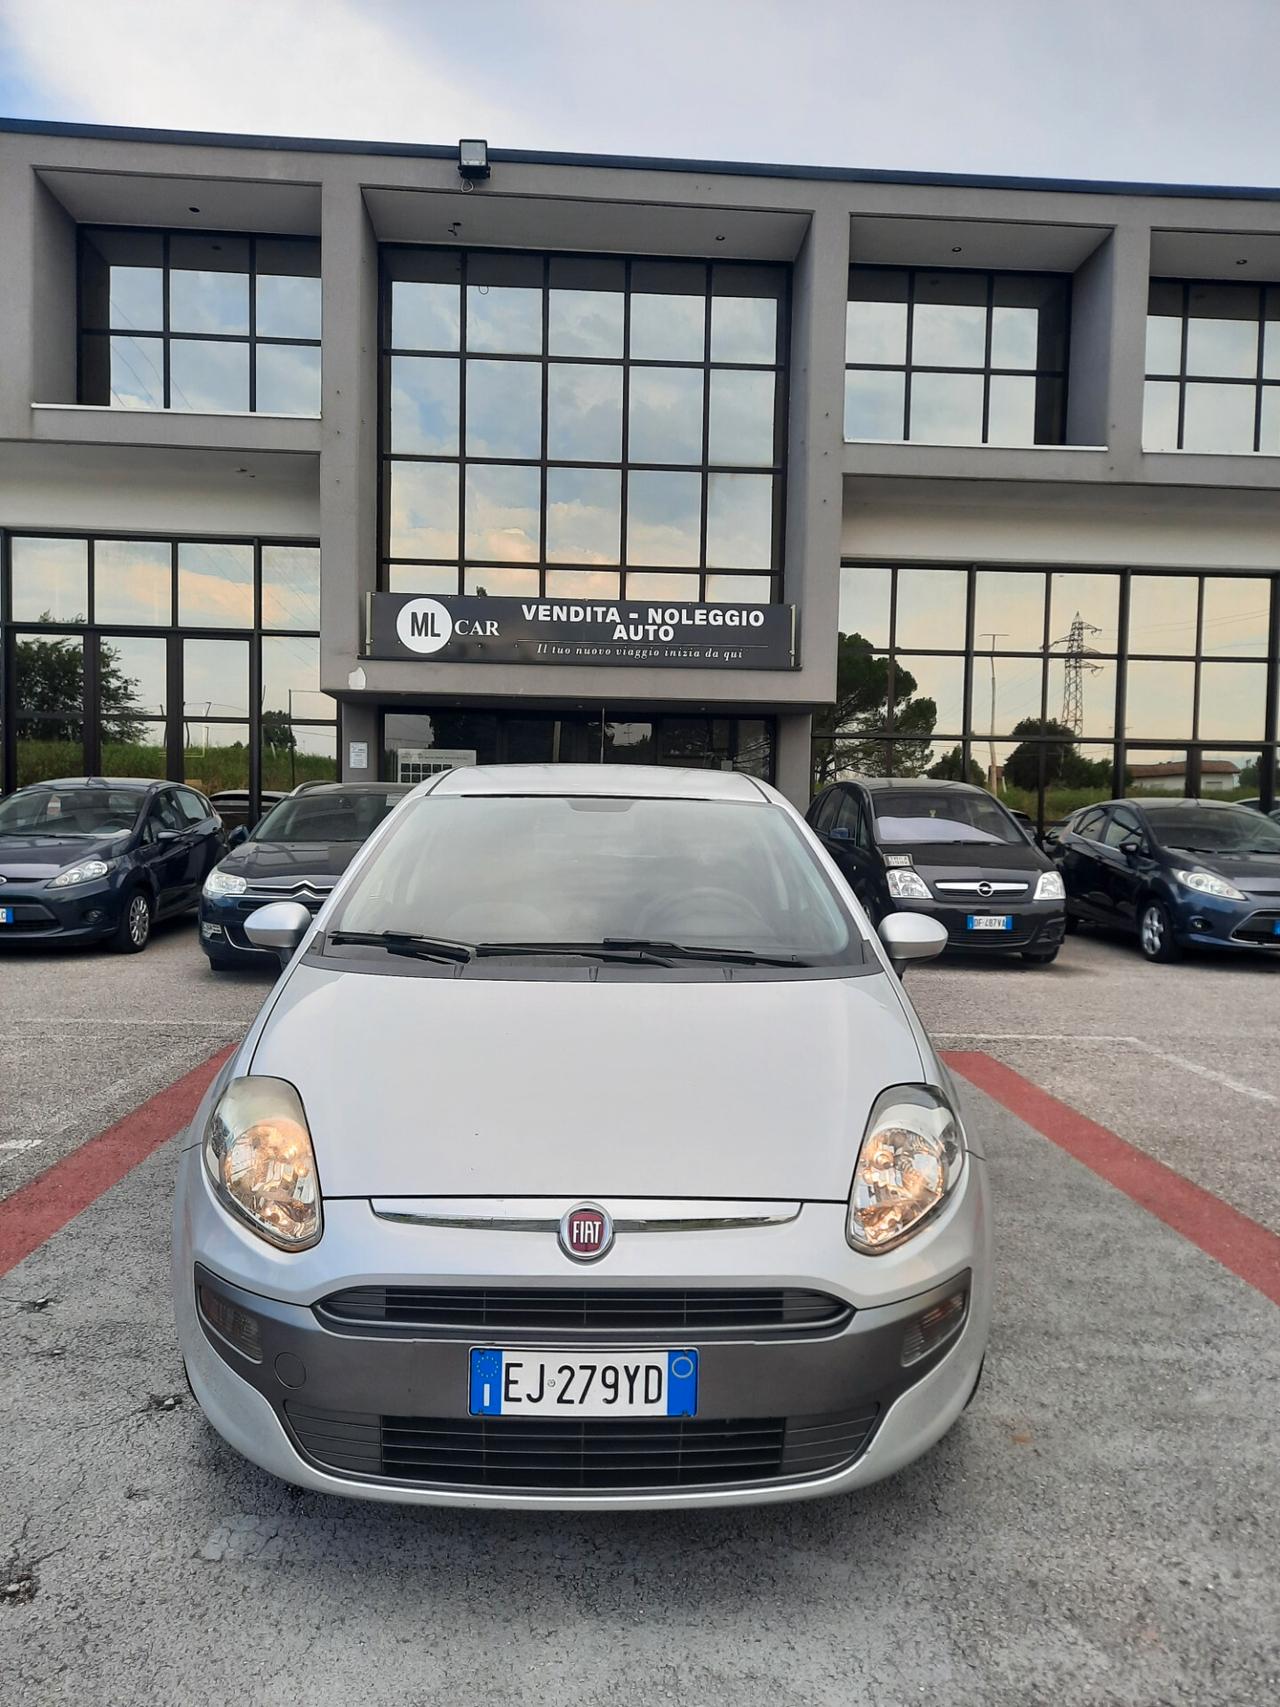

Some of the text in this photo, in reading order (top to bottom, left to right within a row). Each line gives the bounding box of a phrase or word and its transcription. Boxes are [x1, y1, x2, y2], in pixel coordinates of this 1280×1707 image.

[410, 611, 500, 638] ML CAR
[521, 604, 621, 623] VENDITA
[647, 607, 765, 627] NOLEGGIO
[612, 624, 675, 642] AUTO
[552, 645, 571, 655] tuo
[575, 646, 612, 656] nuovo
[616, 646, 660, 660] viaggio
[664, 646, 700, 658] inizia
[705, 648, 719, 659] da
[723, 648, 743, 662] qui
[572, 1221, 602, 1244] FIAT
